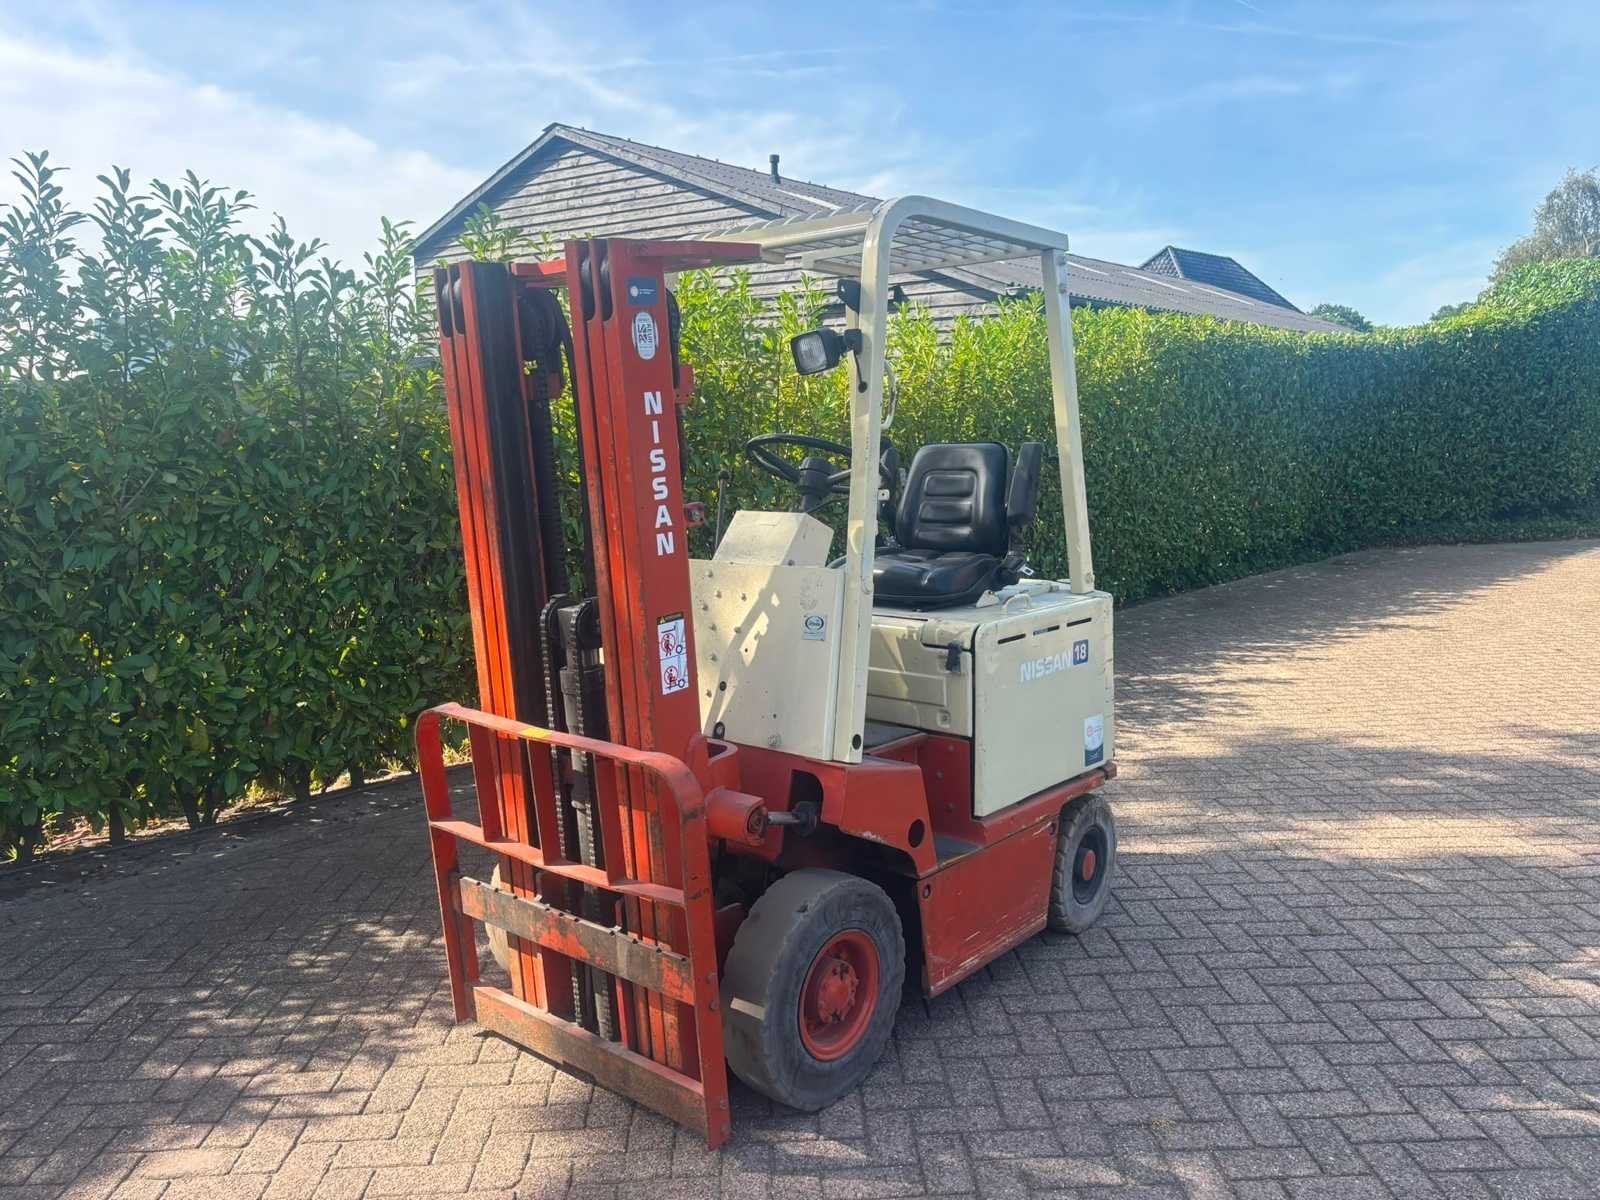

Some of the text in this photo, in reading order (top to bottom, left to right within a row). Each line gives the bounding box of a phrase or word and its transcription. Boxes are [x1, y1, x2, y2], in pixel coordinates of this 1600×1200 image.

[644, 391, 674, 556] NISSAN
[1020, 643, 1087, 682] NISSAN 18
